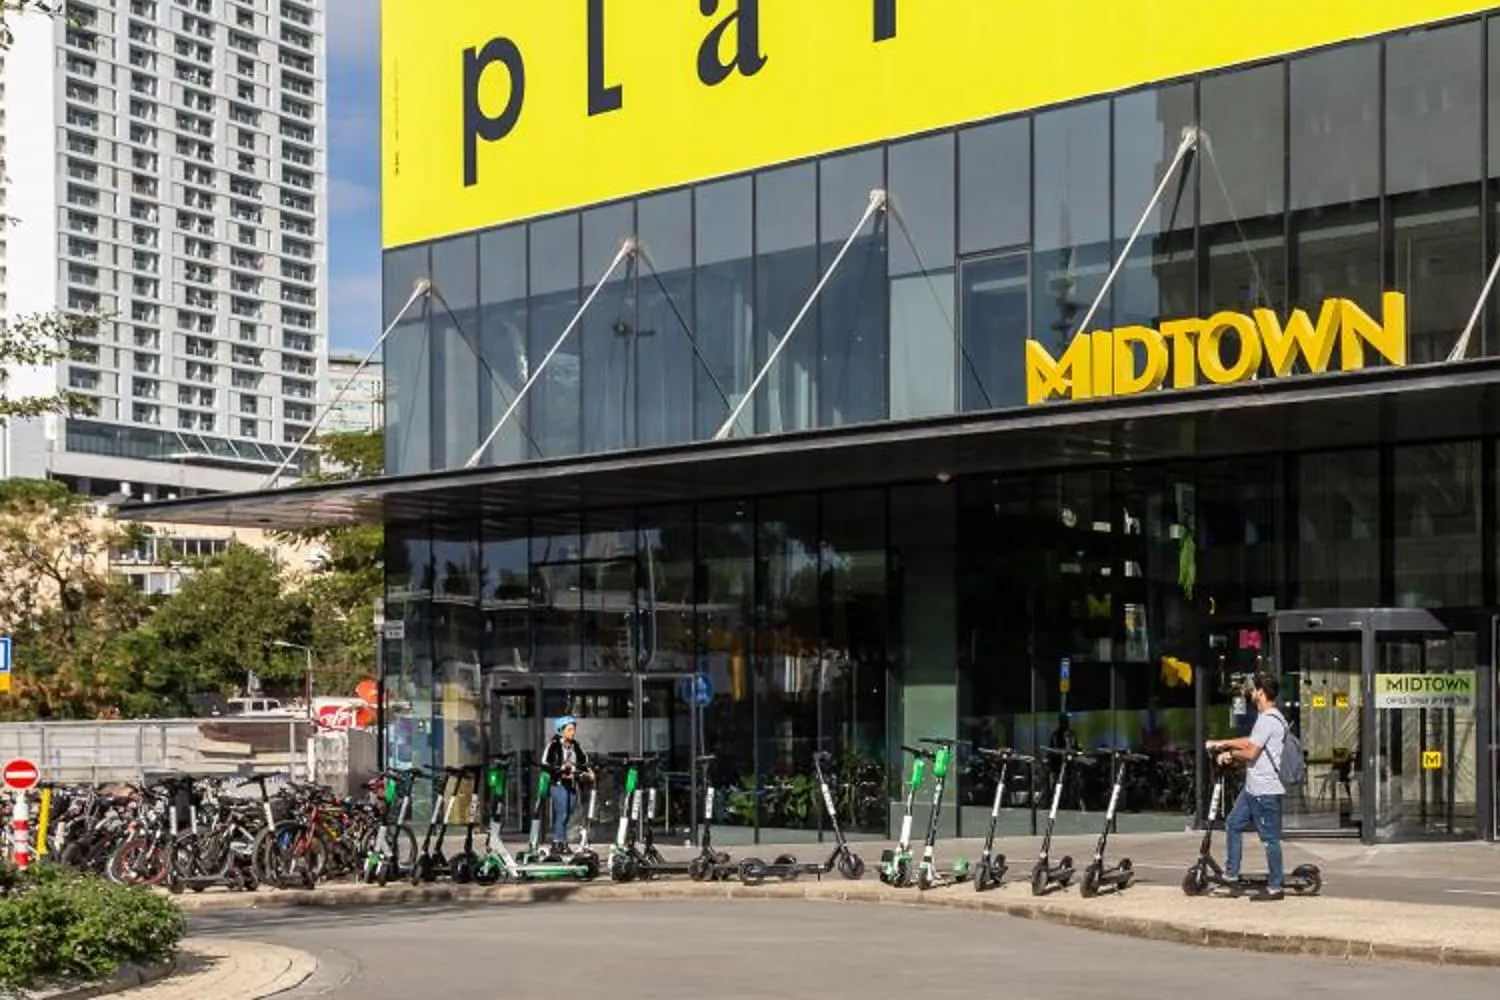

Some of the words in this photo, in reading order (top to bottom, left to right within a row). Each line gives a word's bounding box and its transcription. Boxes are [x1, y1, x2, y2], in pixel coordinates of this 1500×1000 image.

[1026, 291, 1406, 405] MIDTOWN
[1386, 678, 1471, 692] MIDTOWN
[1425, 754, 1439, 765] M
